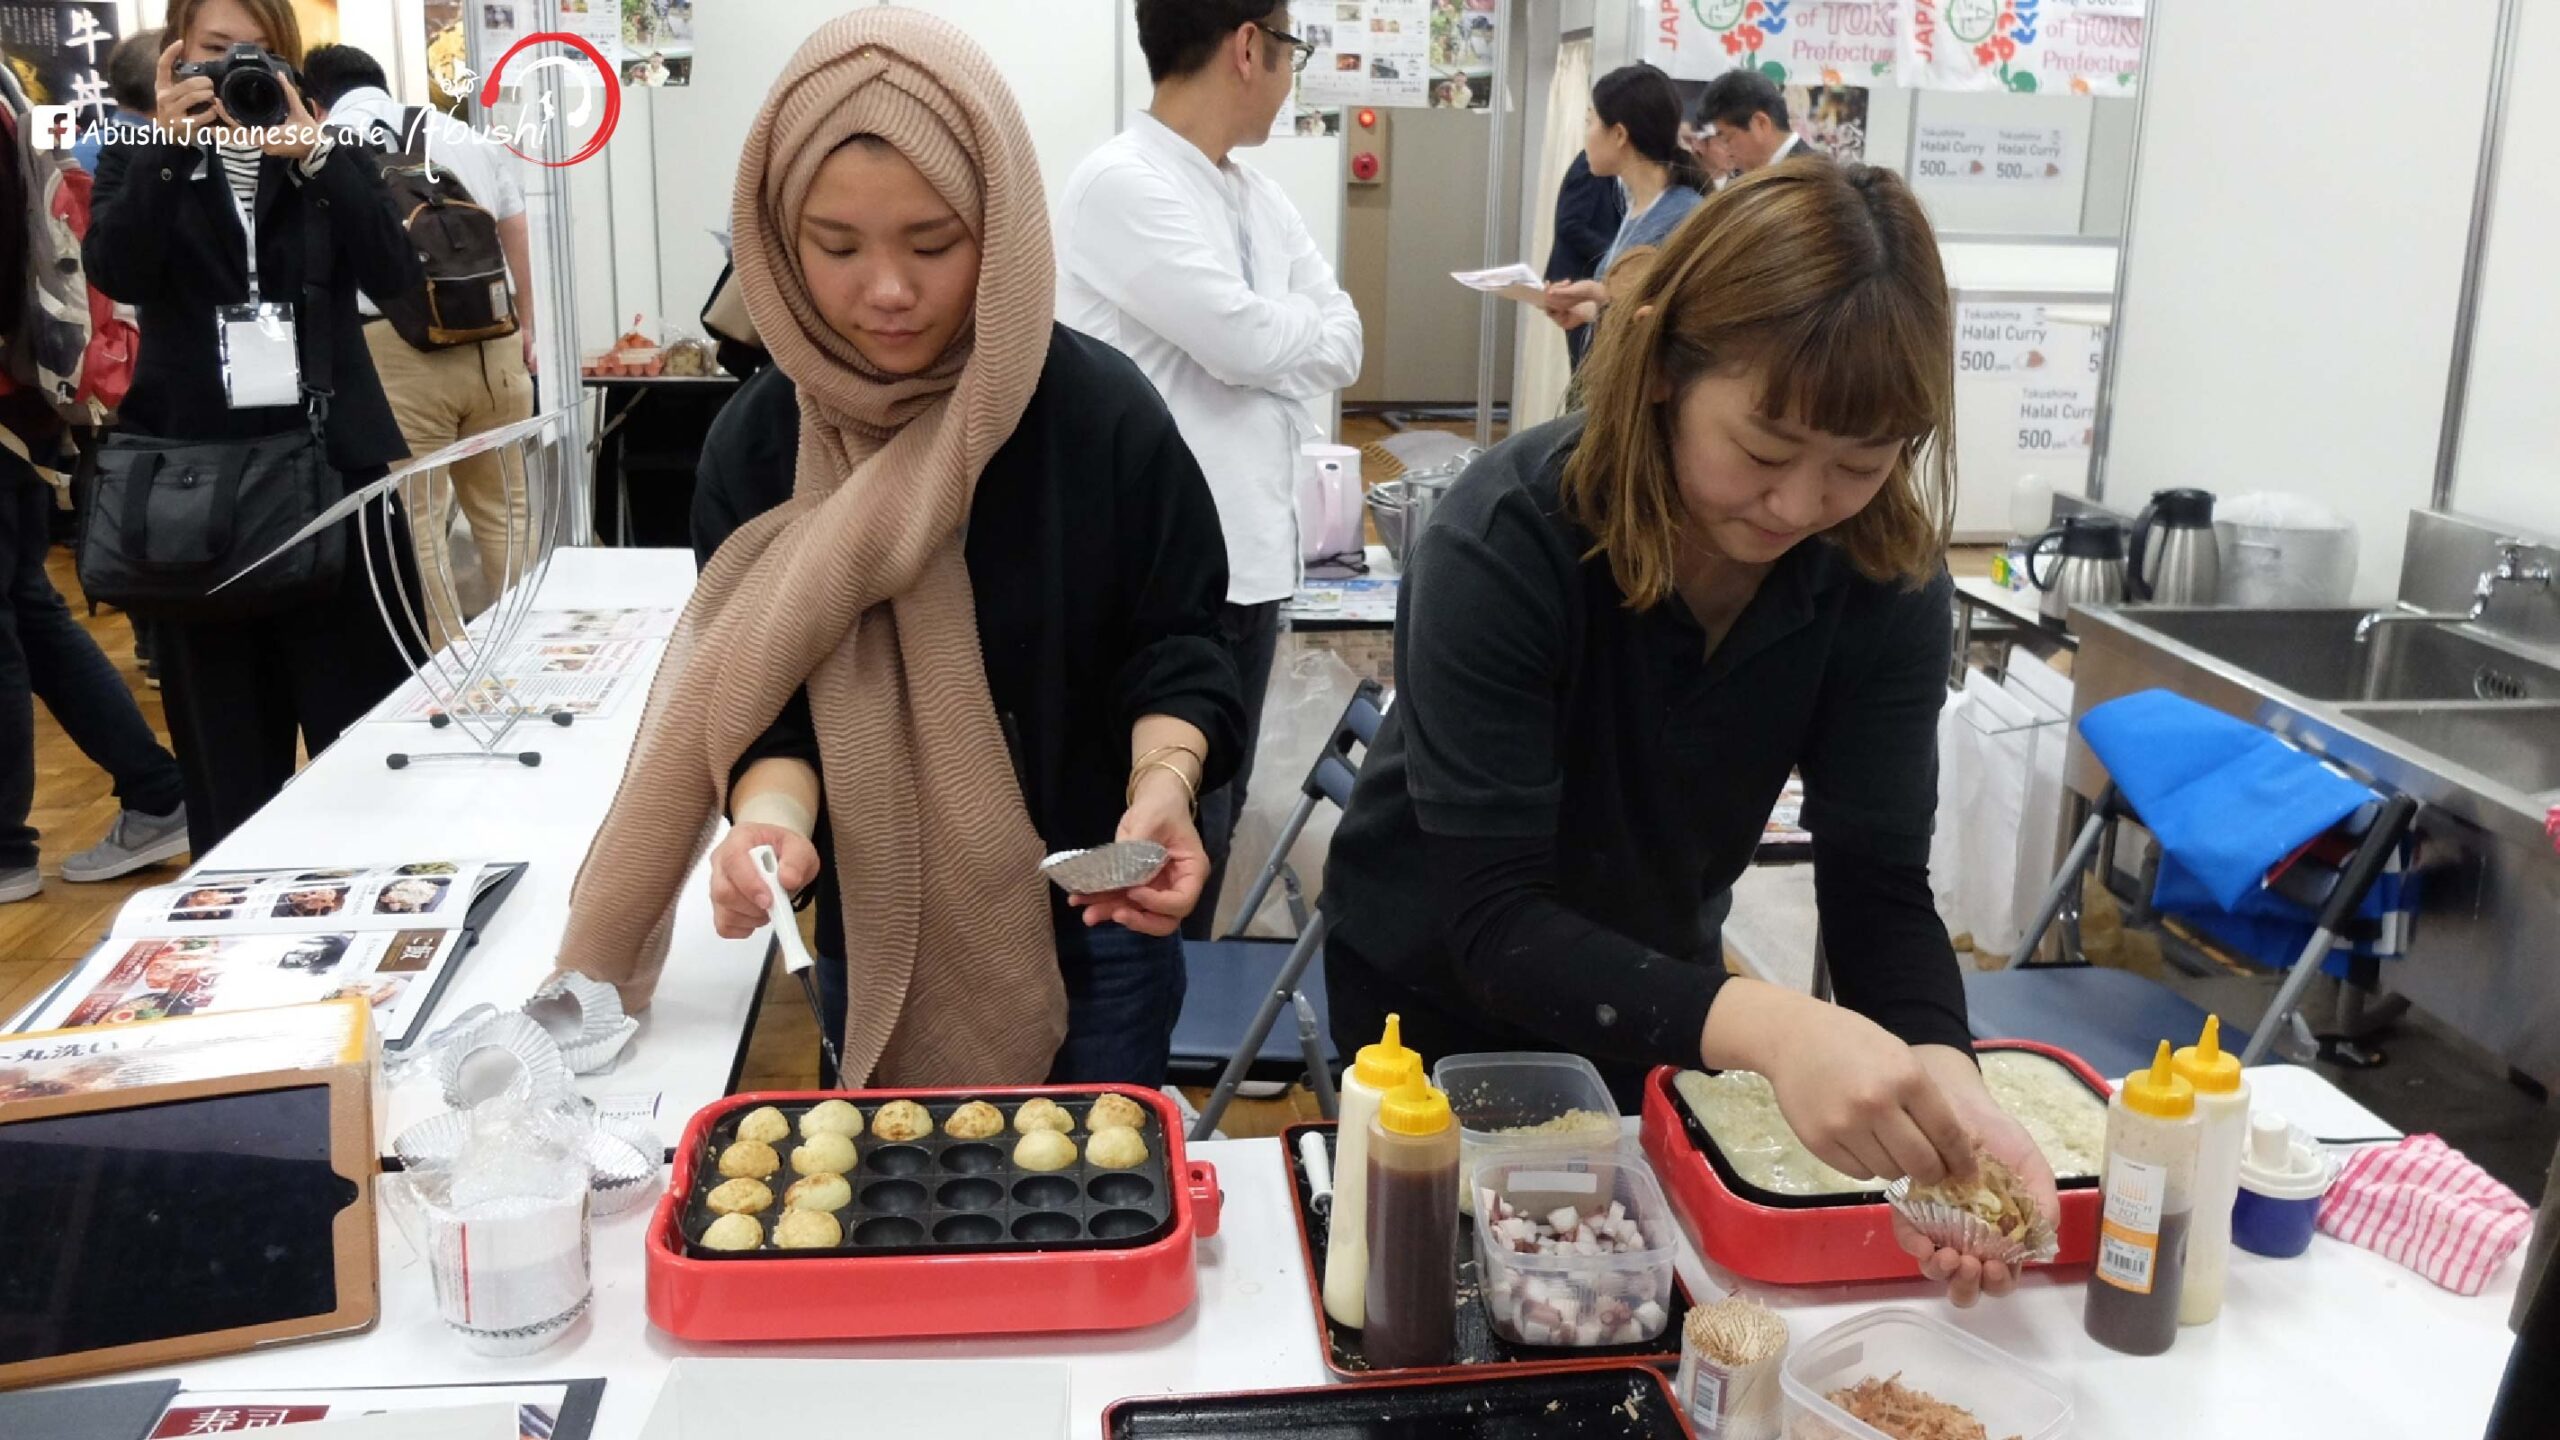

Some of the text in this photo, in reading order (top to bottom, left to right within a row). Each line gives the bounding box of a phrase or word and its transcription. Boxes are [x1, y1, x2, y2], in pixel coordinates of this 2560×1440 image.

[1796, 2, 1897, 37] of TOK
[2045, 15, 2143, 48] of TOK
[65, 8, 119, 126] 牛丼
[1921, 141, 1985, 155] Halal Curry
[1997, 143, 2061, 158] Halal Curry
[1919, 160, 1946, 176] 500
[1996, 163, 2022, 178] 500
[1962, 325, 2047, 345] Halal Curry
[1960, 350, 1995, 371] 500
[2020, 403, 2094, 419] Halal Curr
[2018, 429, 2052, 449] 500
[188, 1408, 289, 1434] 寿司
